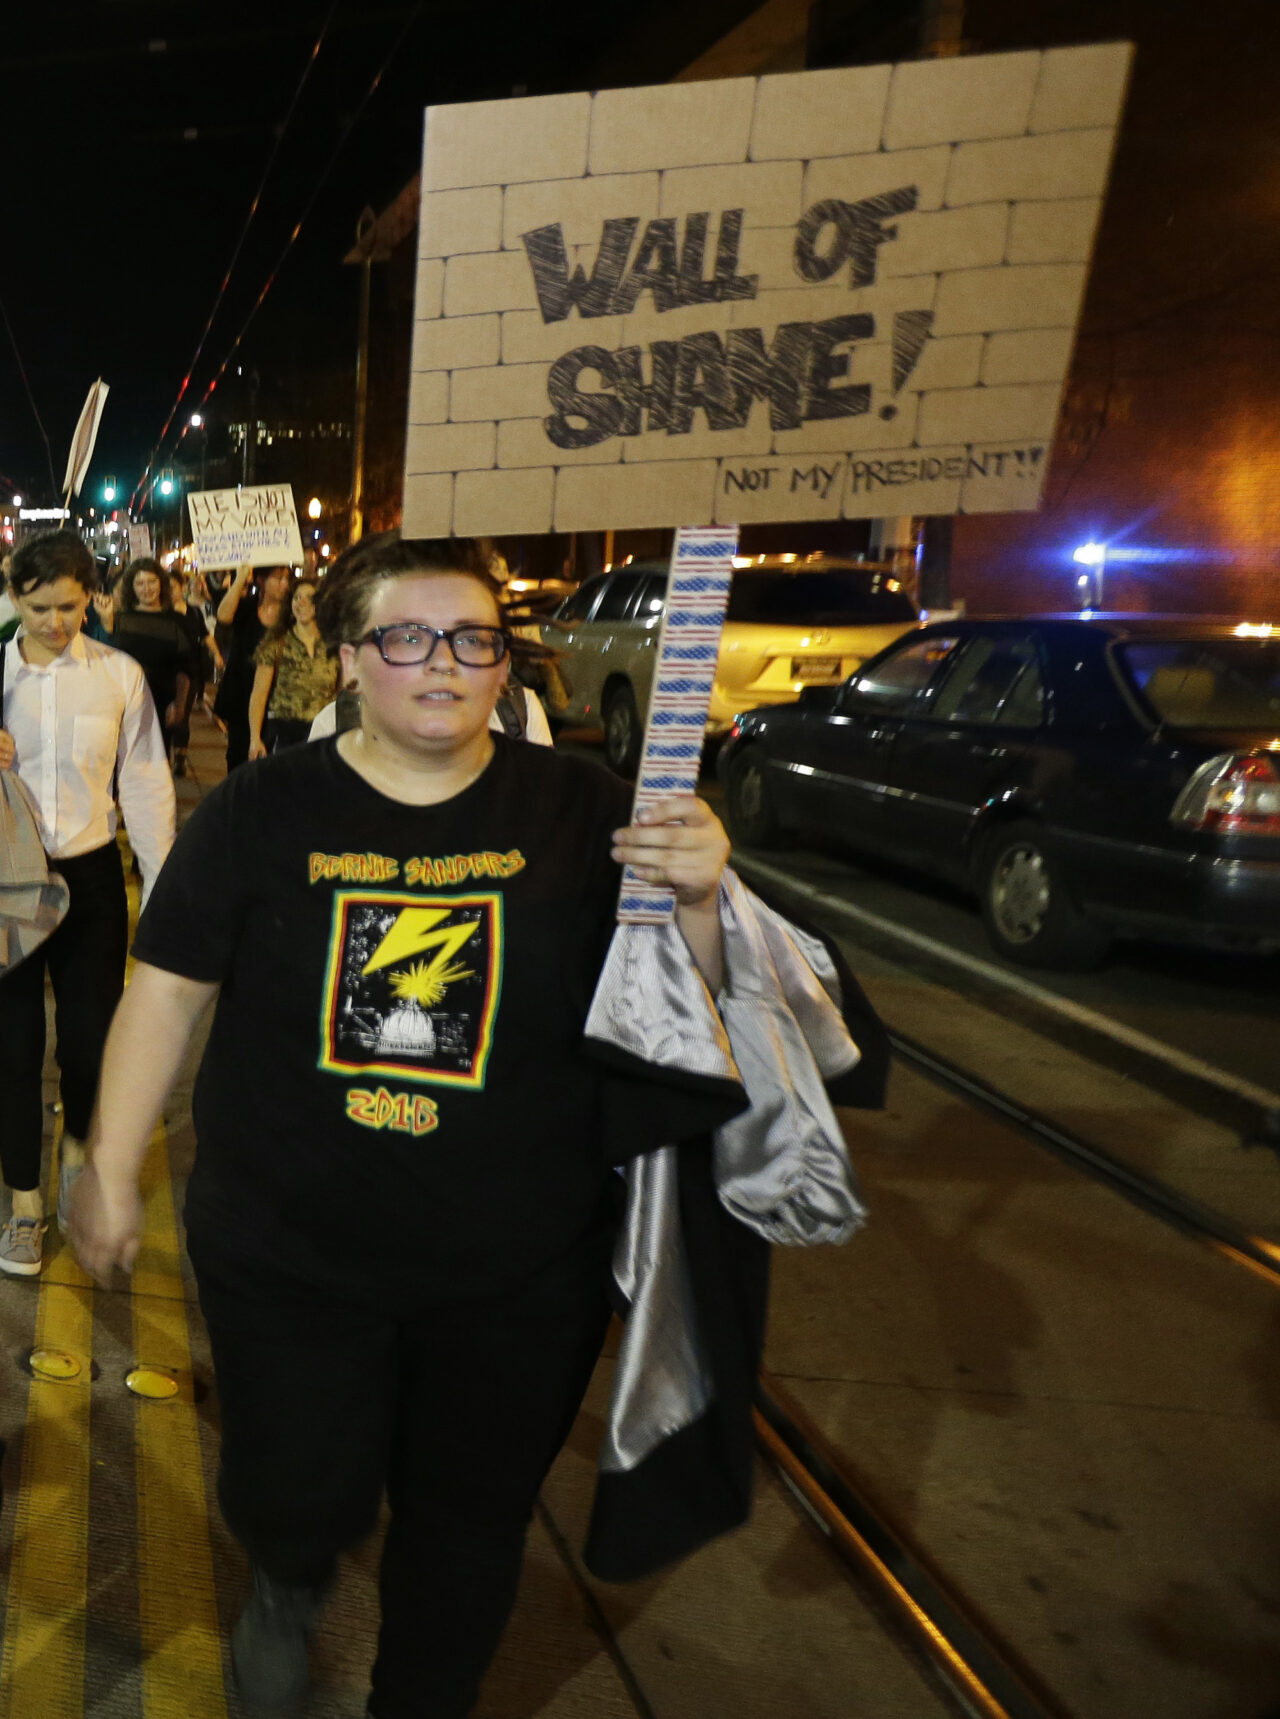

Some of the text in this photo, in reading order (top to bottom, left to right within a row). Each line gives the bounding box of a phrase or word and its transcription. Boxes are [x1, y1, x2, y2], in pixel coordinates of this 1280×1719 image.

[521, 184, 919, 324] WALL OF
[541, 309, 935, 450] SHAME!
[724, 467, 780, 494] NOT
[790, 461, 842, 499] MY
[309, 849, 526, 887] BERNIE SANDERS
[346, 1086, 439, 1136] 2016
